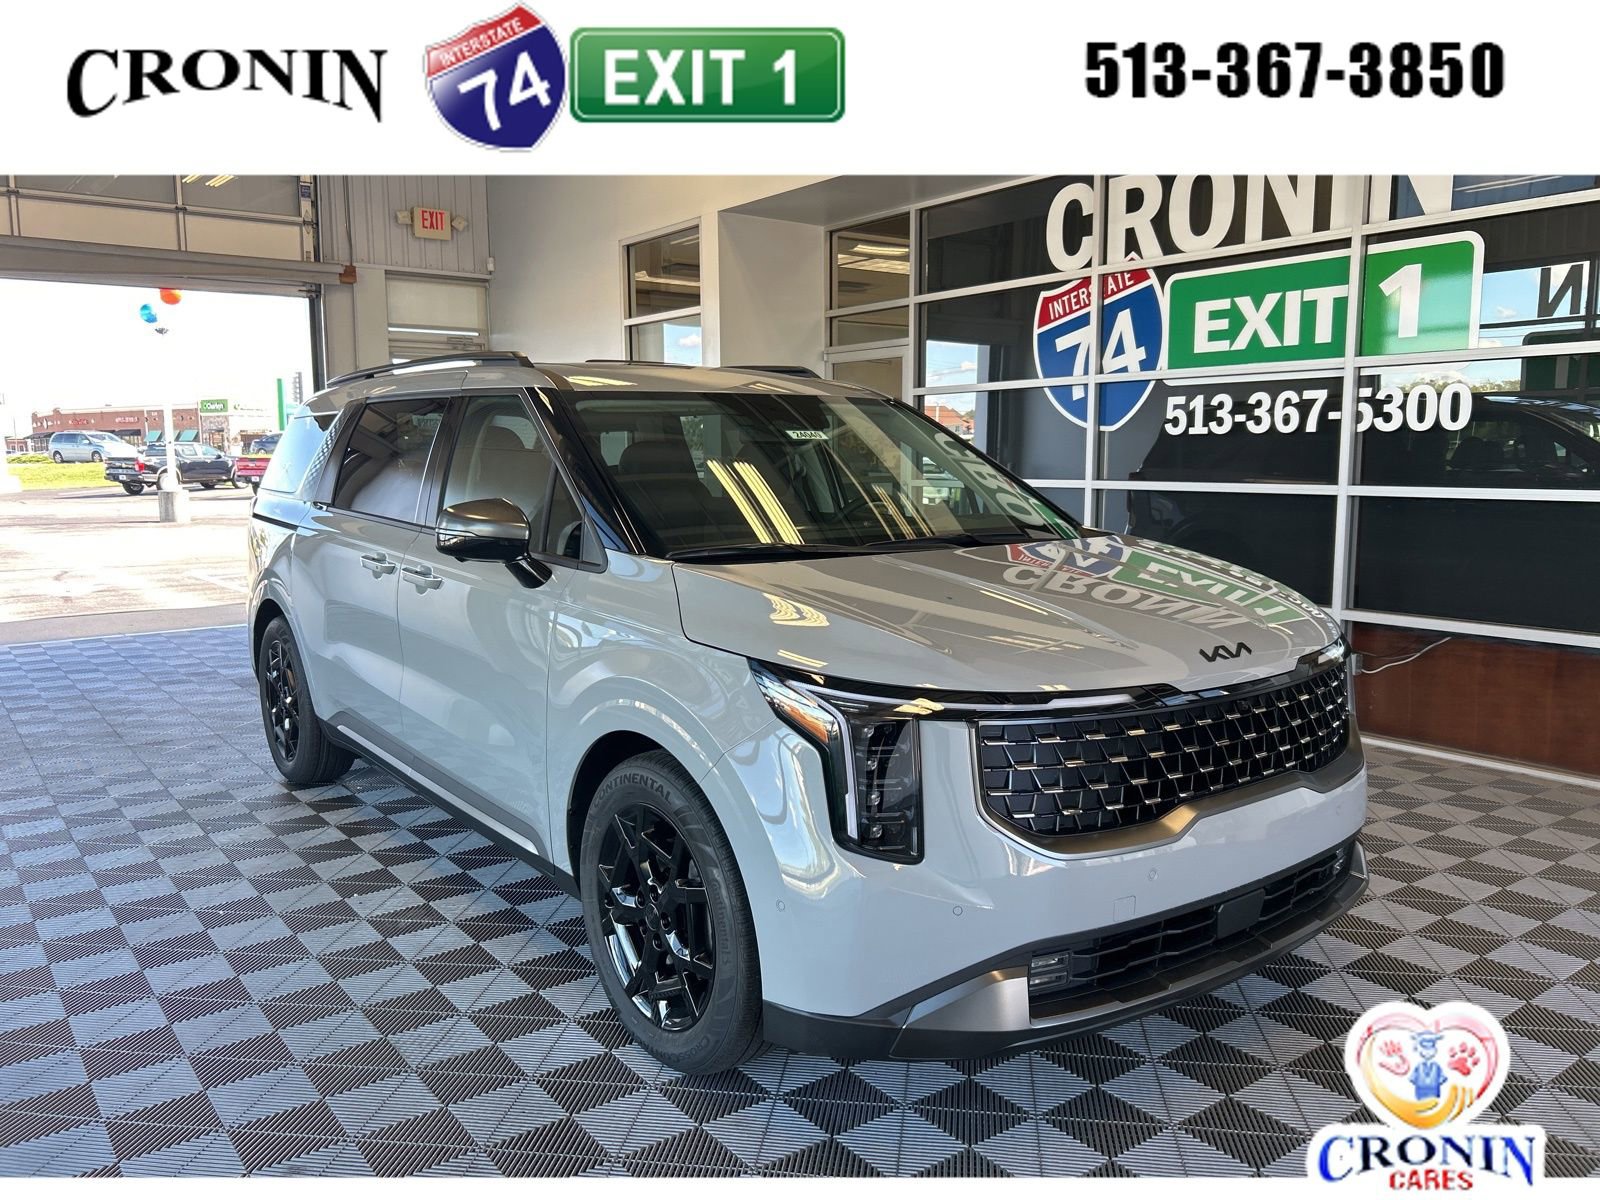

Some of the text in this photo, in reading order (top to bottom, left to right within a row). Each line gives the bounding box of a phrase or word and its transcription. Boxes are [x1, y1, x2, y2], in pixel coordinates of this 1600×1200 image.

[421, 210, 445, 230] EXIT
[1046, 174, 1453, 272] CRONIN
[1194, 263, 1422, 354] EXIT 1
[1055, 308, 1147, 401] 74
[593, 773, 672, 808] CONTINENTAL
